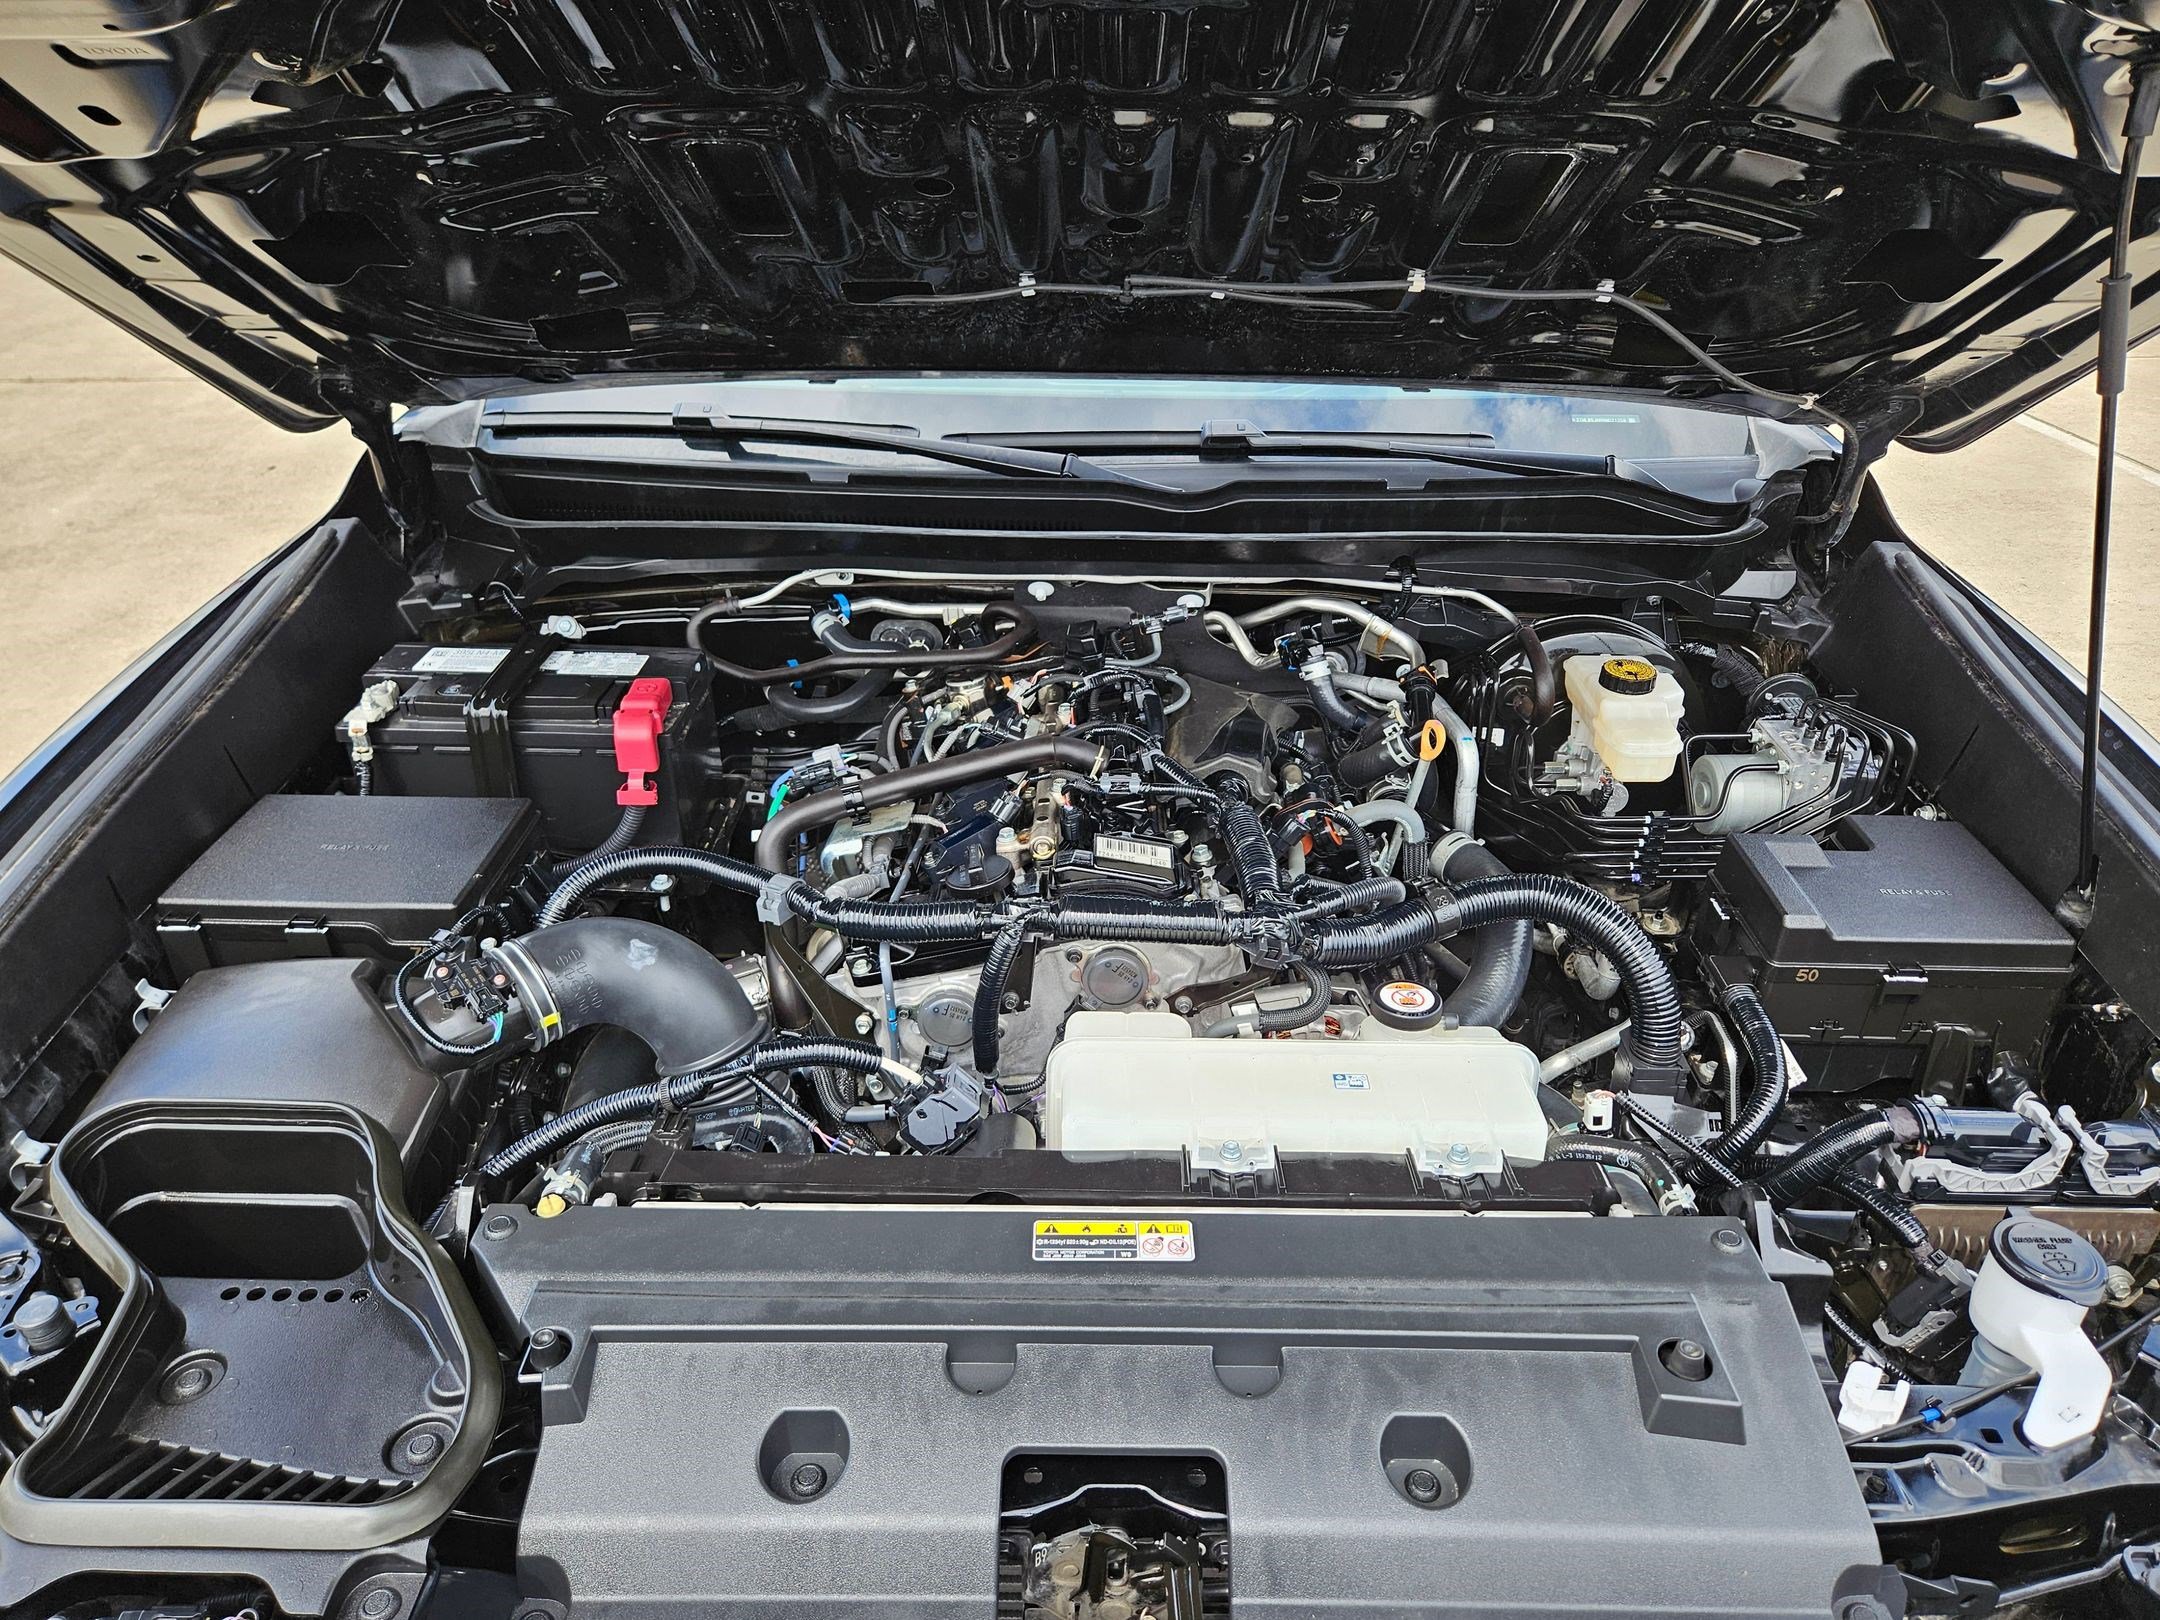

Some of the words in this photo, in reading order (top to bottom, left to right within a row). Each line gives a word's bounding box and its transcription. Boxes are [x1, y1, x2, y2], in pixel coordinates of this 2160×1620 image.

[83, 47, 151, 55] TOYOTA
[1795, 968, 1819, 982] 50
[1034, 1547, 1048, 1568] B9
